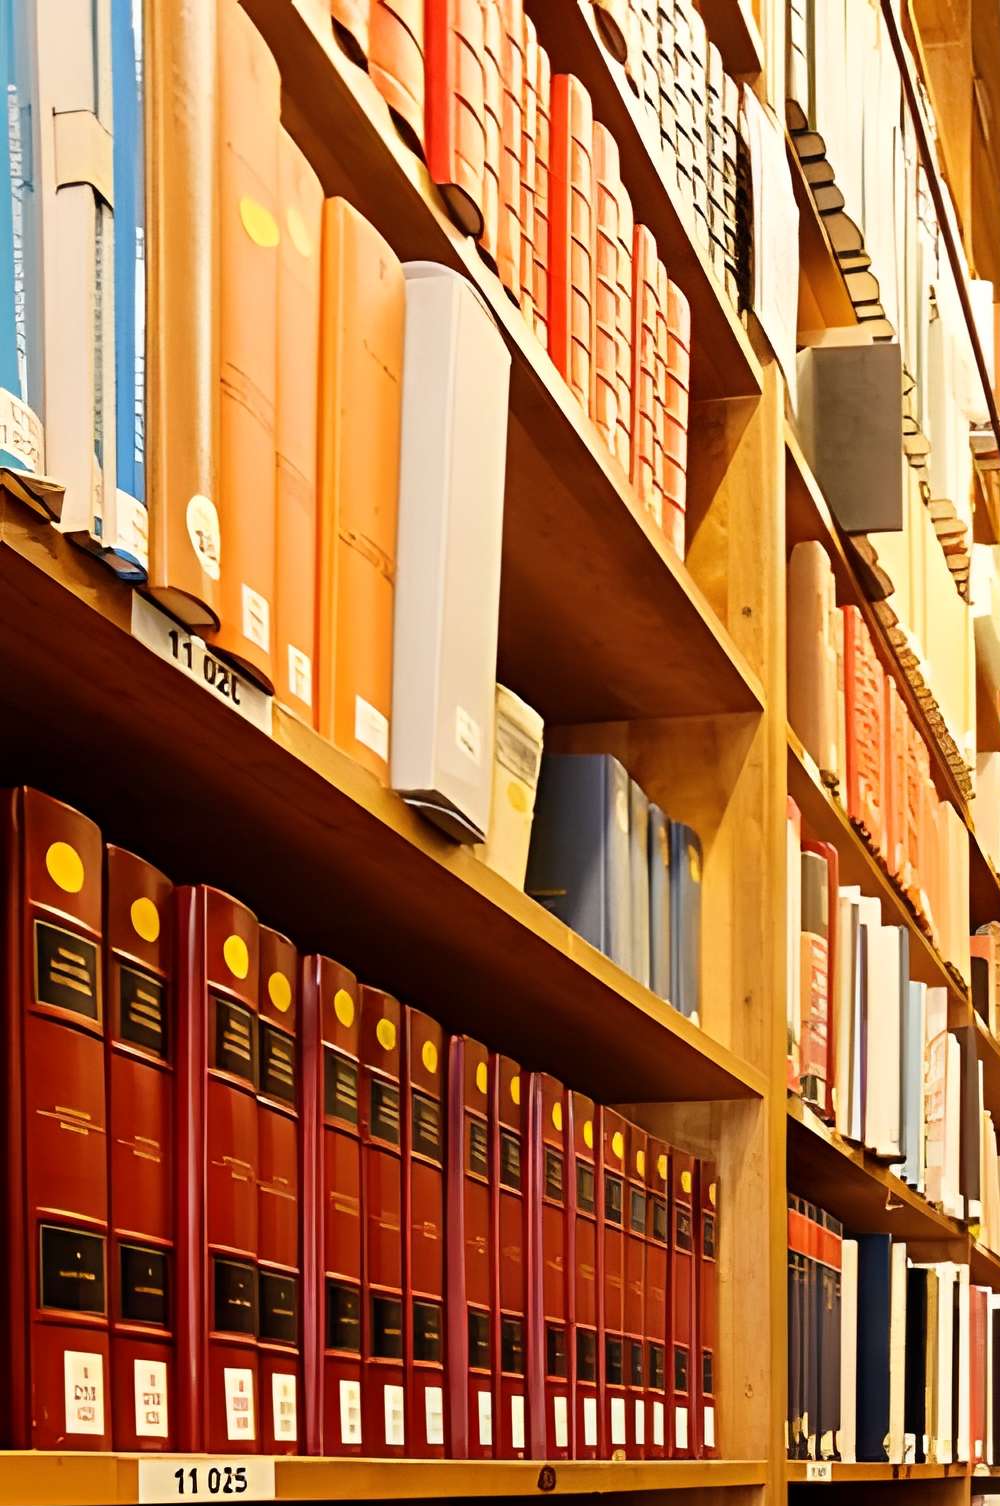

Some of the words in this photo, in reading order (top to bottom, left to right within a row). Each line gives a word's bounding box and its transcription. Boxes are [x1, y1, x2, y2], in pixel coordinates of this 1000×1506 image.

[168, 630, 193, 669] 11
[174, 1467, 198, 1494] 11
[208, 1466, 248, 1494] 025
